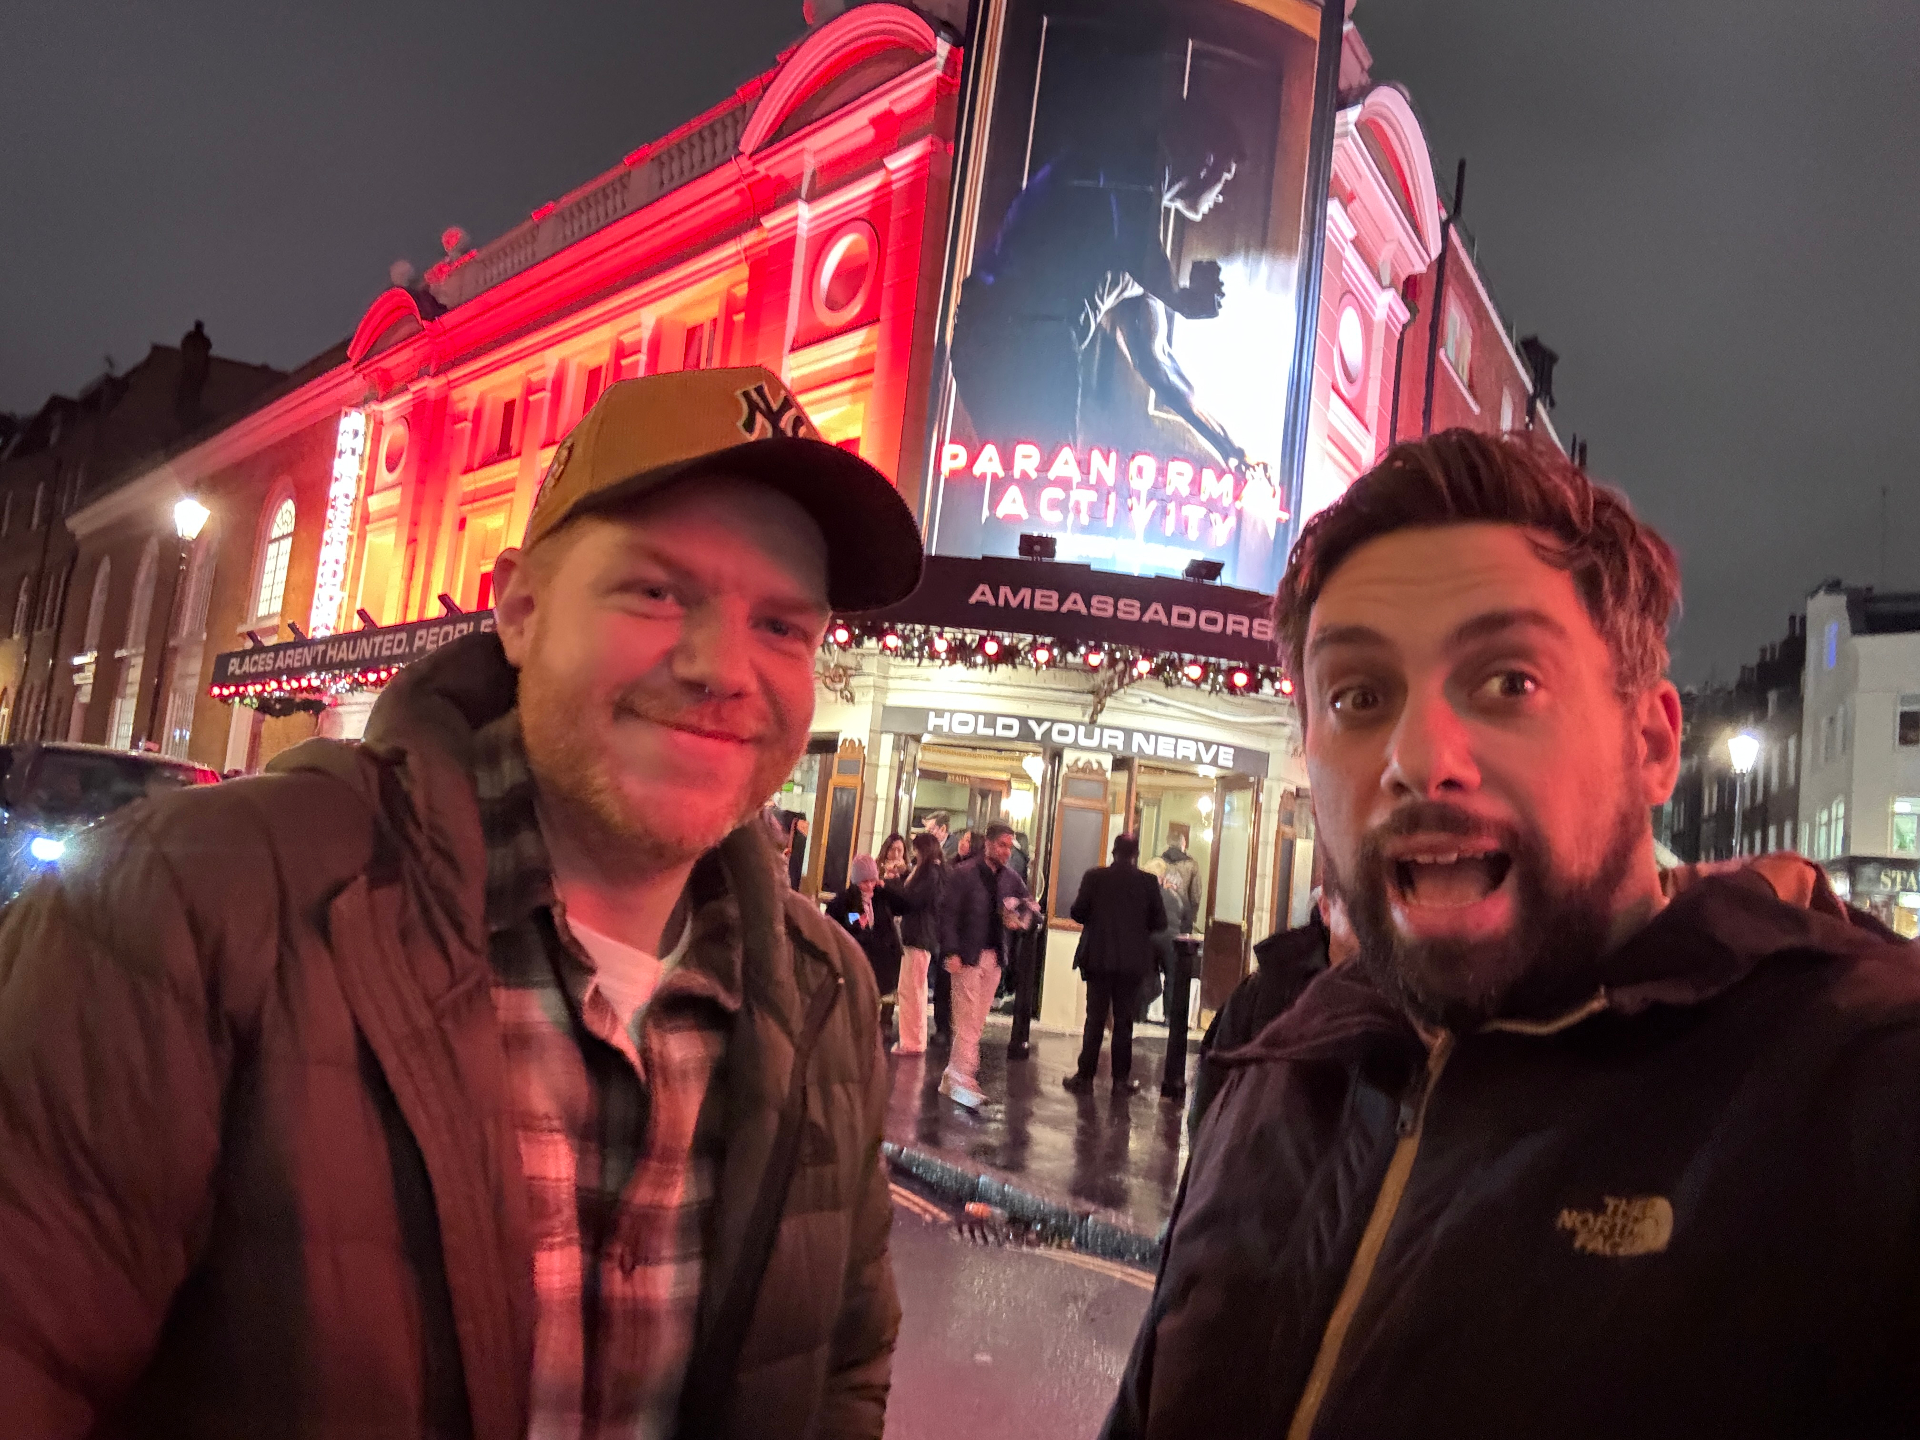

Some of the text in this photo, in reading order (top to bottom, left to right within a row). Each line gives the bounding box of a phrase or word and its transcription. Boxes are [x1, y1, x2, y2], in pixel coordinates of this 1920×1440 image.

[941, 443, 1290, 524] PARANORM
[995, 484, 1236, 547] ACTIVITY
[968, 583, 1275, 641] AMBASSADORS
[228, 652, 275, 676] PLACES
[274, 644, 327, 671] AREN'T
[326, 631, 409, 664] HAUNTED.
[927, 710, 1236, 769] HOLD YOUR NERVE
